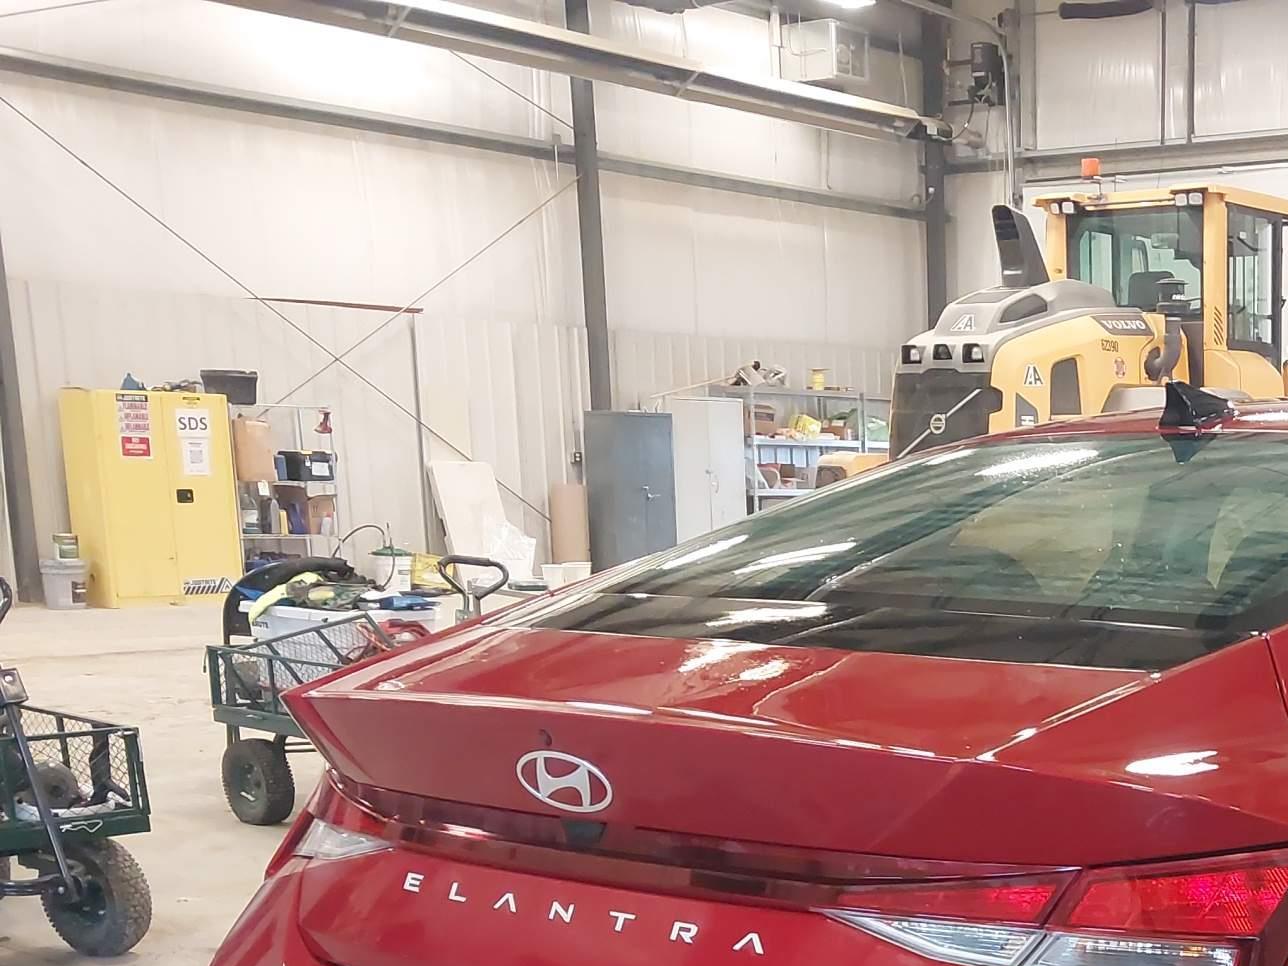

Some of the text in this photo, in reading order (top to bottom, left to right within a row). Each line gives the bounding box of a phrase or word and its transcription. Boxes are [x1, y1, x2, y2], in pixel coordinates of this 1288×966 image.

[1101, 320, 1146, 330] VOLVO
[178, 417, 208, 431] SDS
[403, 872, 764, 955] ELANTRA
